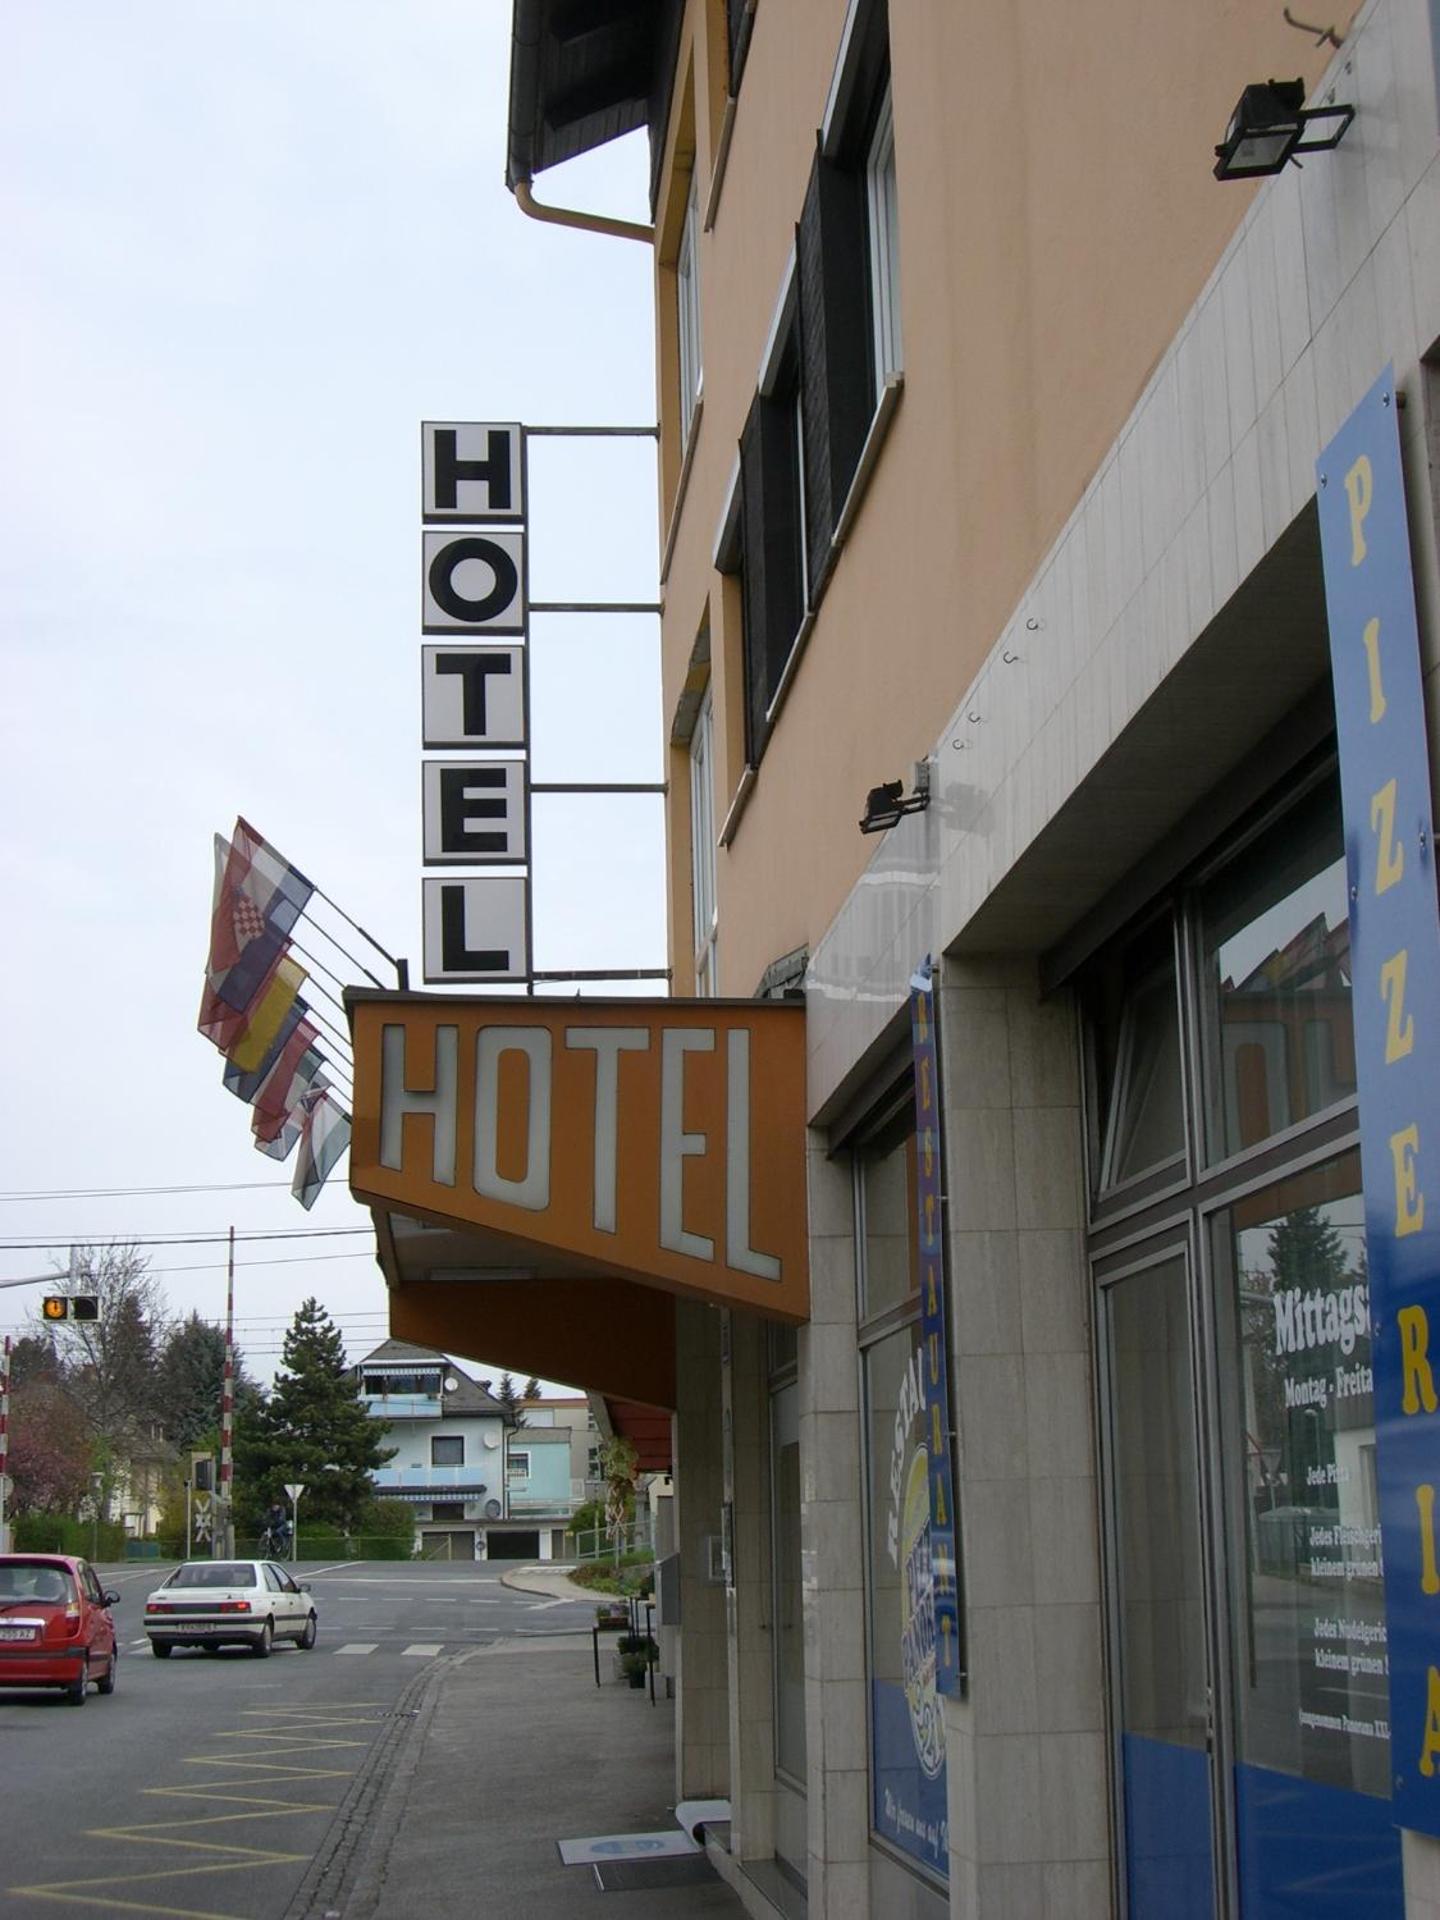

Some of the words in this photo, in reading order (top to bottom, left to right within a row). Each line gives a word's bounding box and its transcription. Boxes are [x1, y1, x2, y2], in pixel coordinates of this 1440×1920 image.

[429, 429, 518, 972] HOTEL
[380, 1024, 782, 1283] HOTEL
[1344, 453, 1440, 1777] PIZZERIA
[1273, 1284, 1372, 1356] Mittags
[1284, 1376, 1327, 1409] Montag
